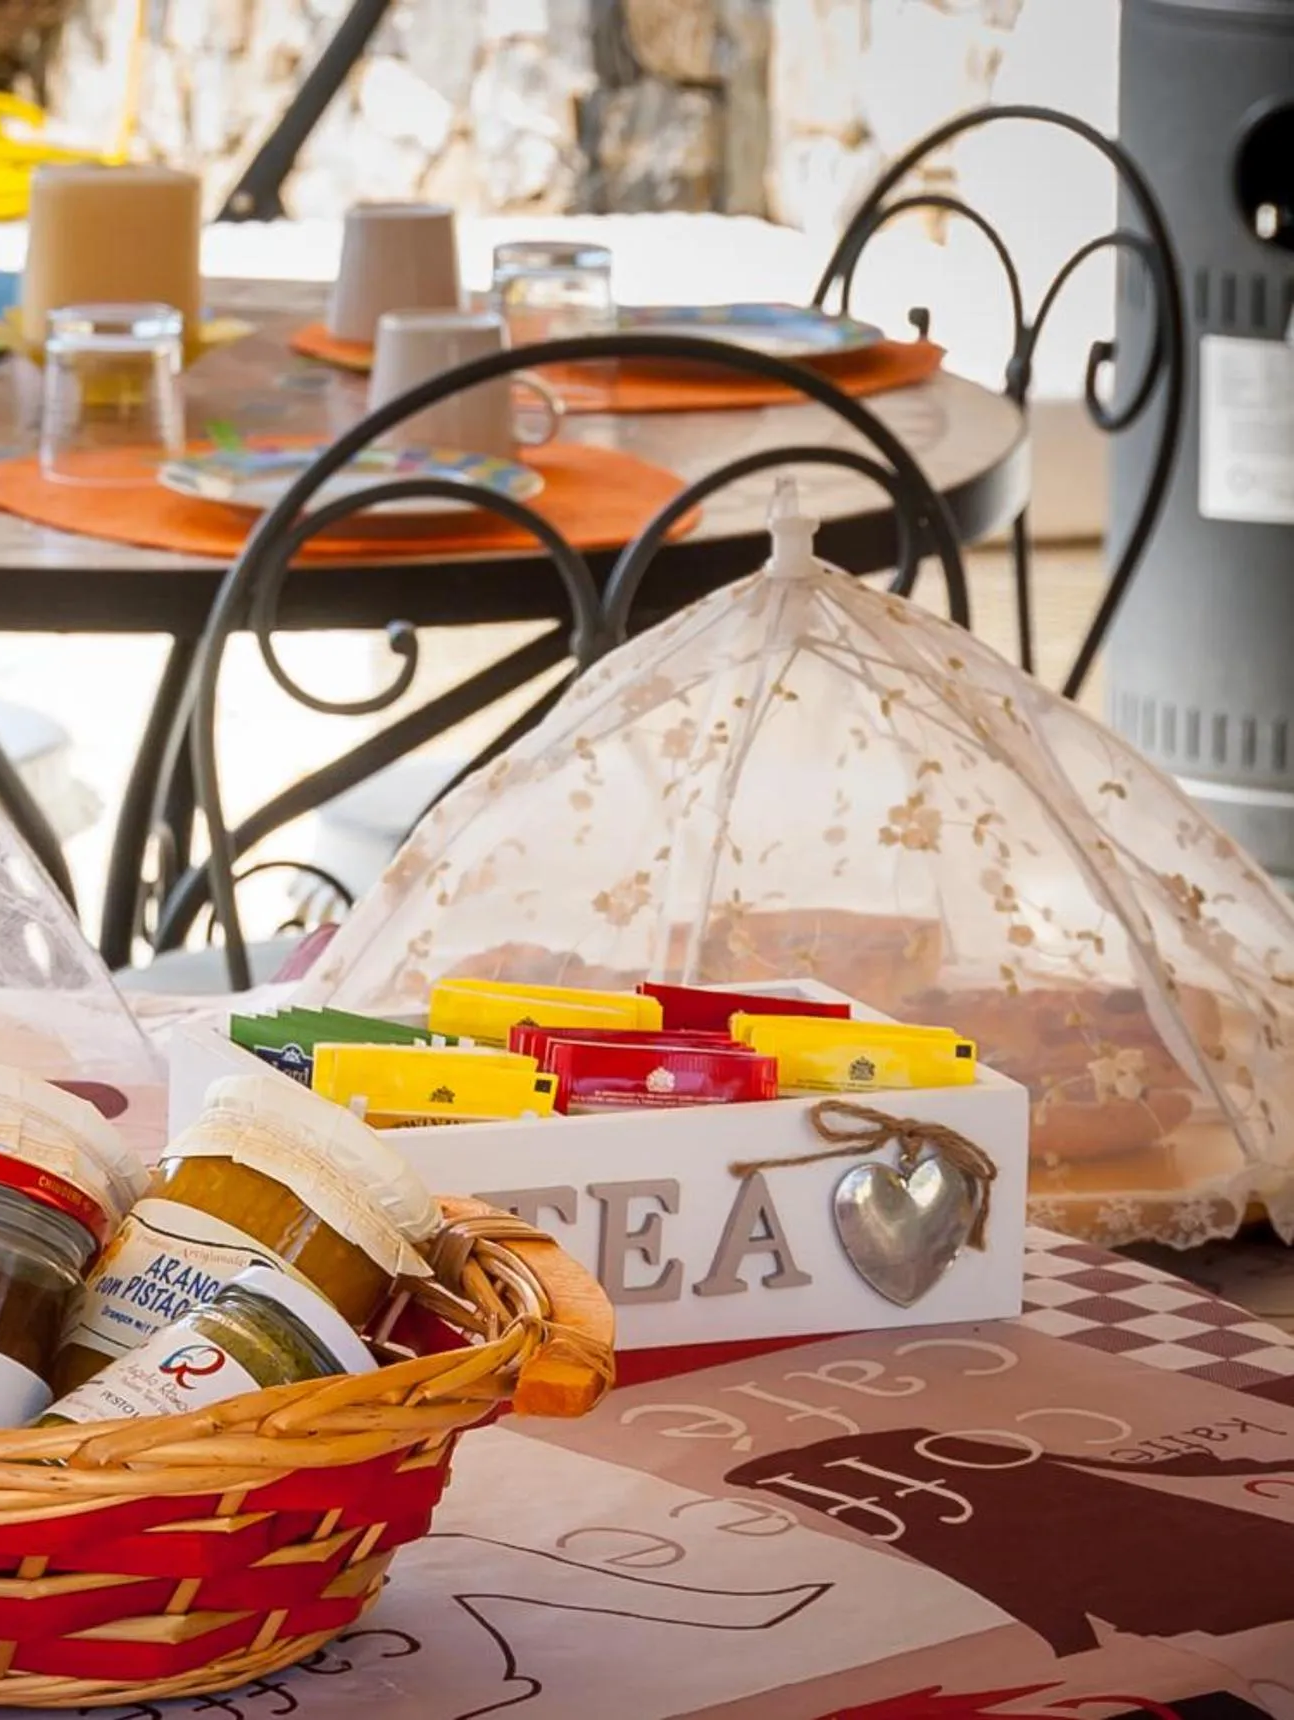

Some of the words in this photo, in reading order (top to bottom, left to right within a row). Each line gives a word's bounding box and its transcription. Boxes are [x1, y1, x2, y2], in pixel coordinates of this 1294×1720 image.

[472, 1170, 812, 1304] TEA
[93, 1276, 123, 1298] con
[120, 1274, 190, 1320] PISTAC
[145, 1253, 220, 1304] ARANC
